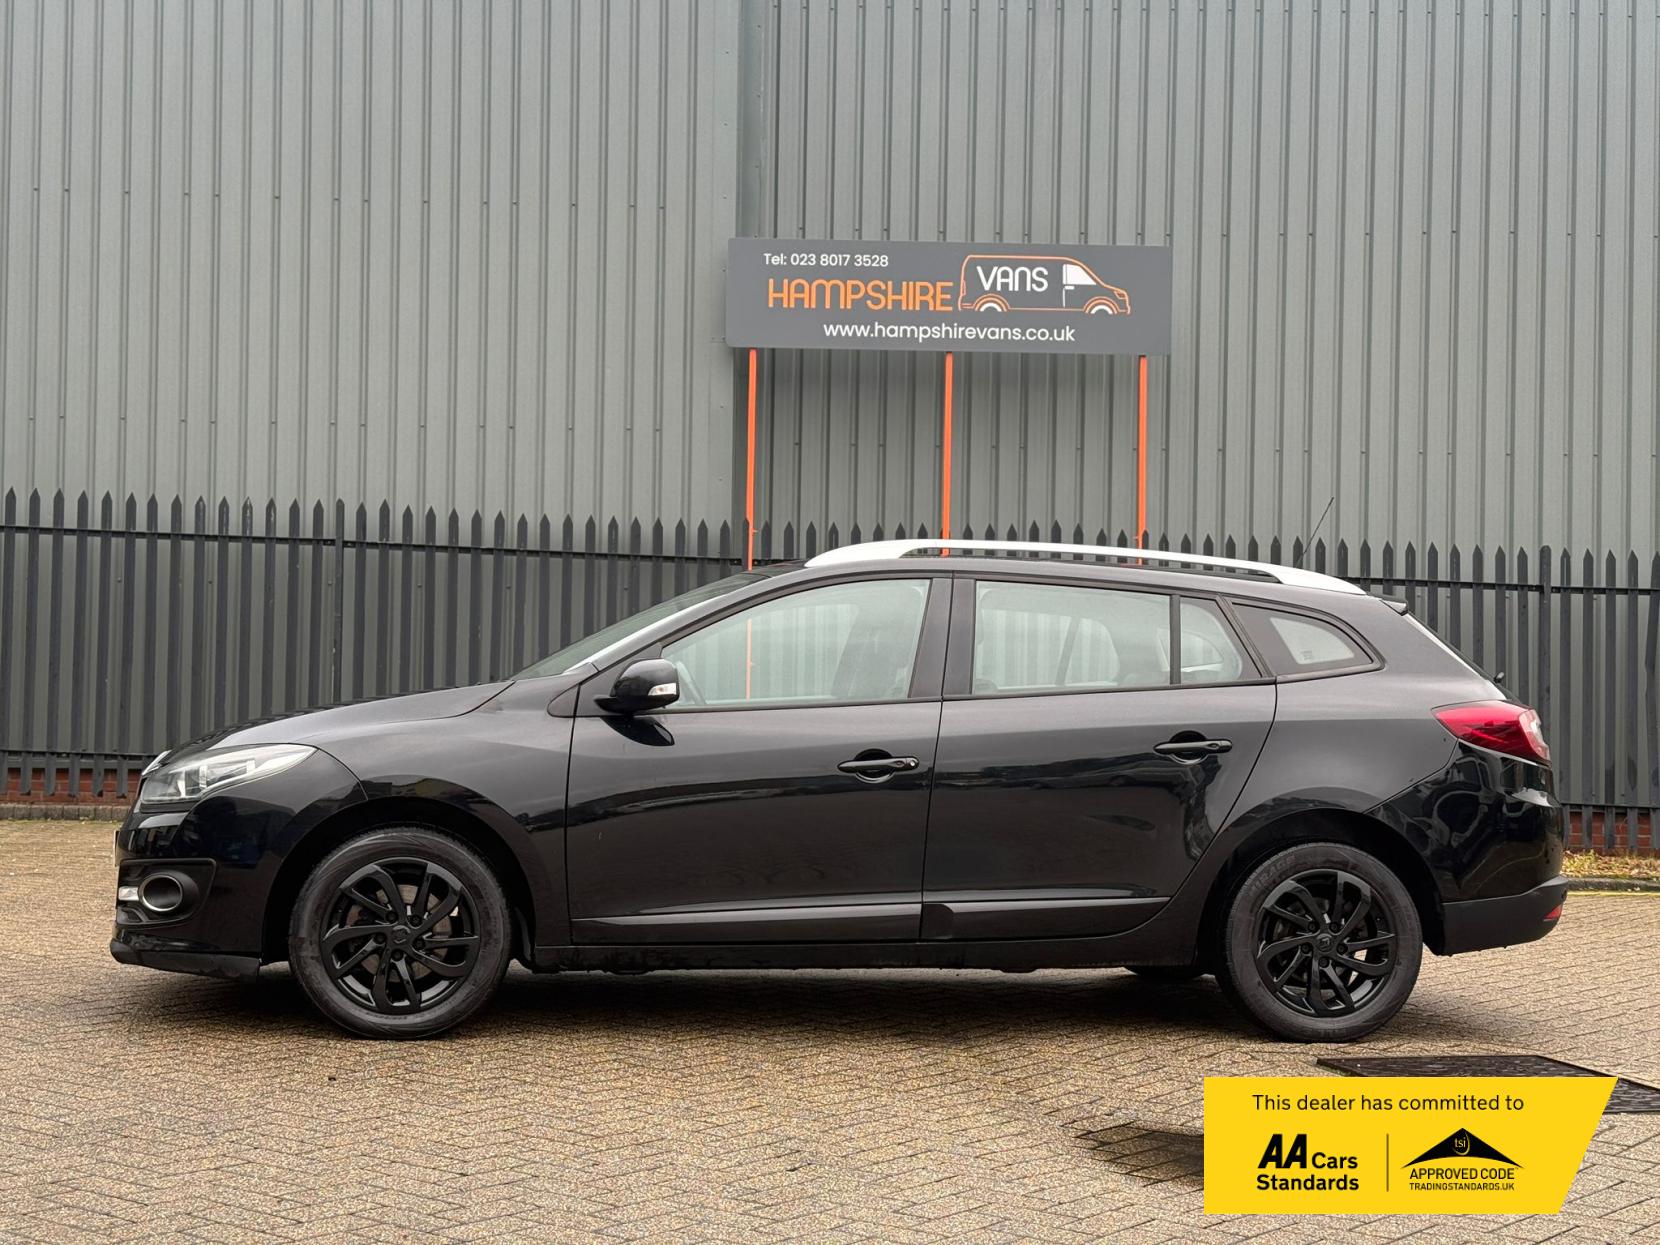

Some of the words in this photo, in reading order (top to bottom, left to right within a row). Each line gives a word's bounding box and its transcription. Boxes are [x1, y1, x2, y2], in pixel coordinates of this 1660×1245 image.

[763, 252, 787, 266] Tel:
[790, 253, 816, 266] 023
[819, 253, 851, 267] 8017
[853, 254, 889, 267] 3528
[767, 278, 954, 311] HAMPSHIRE
[976, 265, 1049, 292] VANS
[823, 321, 1076, 343] www.hampshirevans.co.uk
